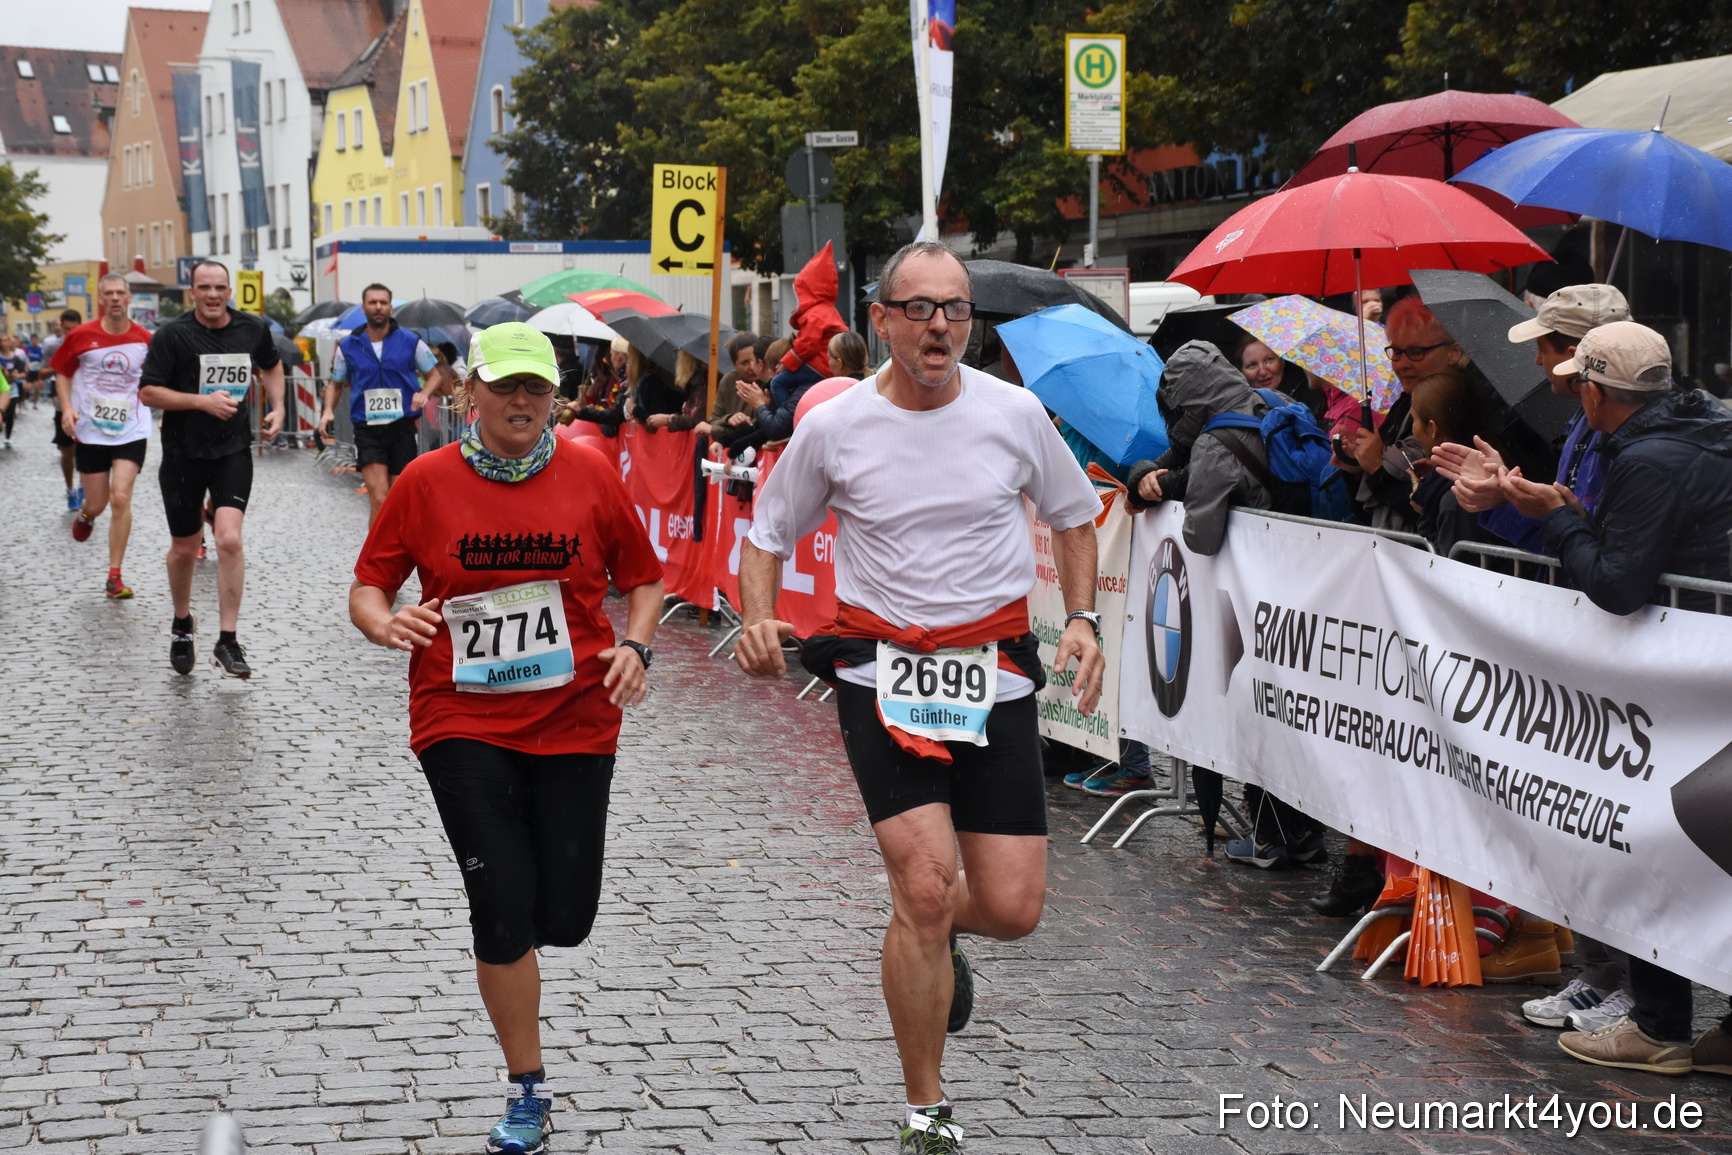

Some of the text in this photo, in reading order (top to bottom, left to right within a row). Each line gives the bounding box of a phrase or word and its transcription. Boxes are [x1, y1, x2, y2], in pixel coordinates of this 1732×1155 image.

[1086, 54, 1105, 78] H
[1077, 93, 1113, 102] Marktplatz
[662, 170, 717, 191] Block
[670, 198, 706, 252] C
[243, 284, 257, 304] D
[206, 366, 247, 384] 2756
[94, 404, 128, 423] 2226
[369, 397, 398, 411] 2281
[465, 548, 565, 566] RUN FOR BÜRNI
[1148, 541, 1189, 603] BMW
[491, 583, 550, 606] BOCK
[462, 606, 559, 659] 2774
[1254, 600, 1318, 673] BMW
[487, 663, 542, 684] Andrea
[891, 657, 986, 703] 2699
[910, 707, 968, 727] Günther
[1253, 677, 1632, 854] WENIGER VERBRAUCH. MEHR FAHRFREUDE.
